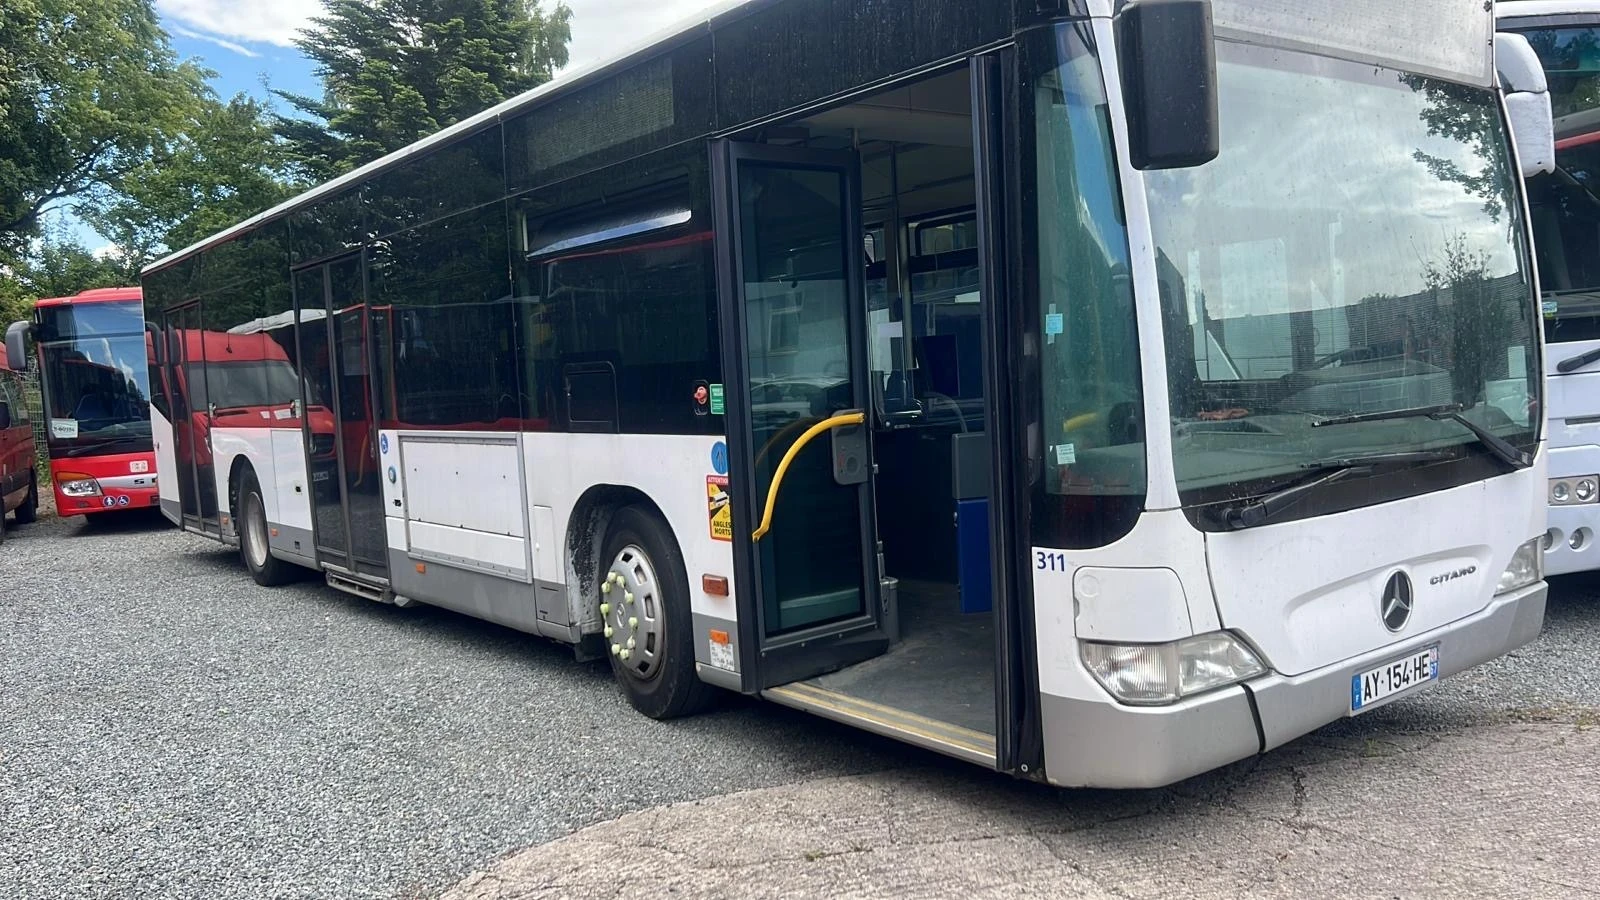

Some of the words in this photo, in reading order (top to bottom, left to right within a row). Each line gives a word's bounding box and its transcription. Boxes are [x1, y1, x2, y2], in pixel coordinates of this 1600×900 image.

[713, 520, 732, 528] ANGLES
[714, 527, 732, 536] MORTS
[1037, 551, 1065, 572] 311
[1429, 566, 1476, 585] CITARO
